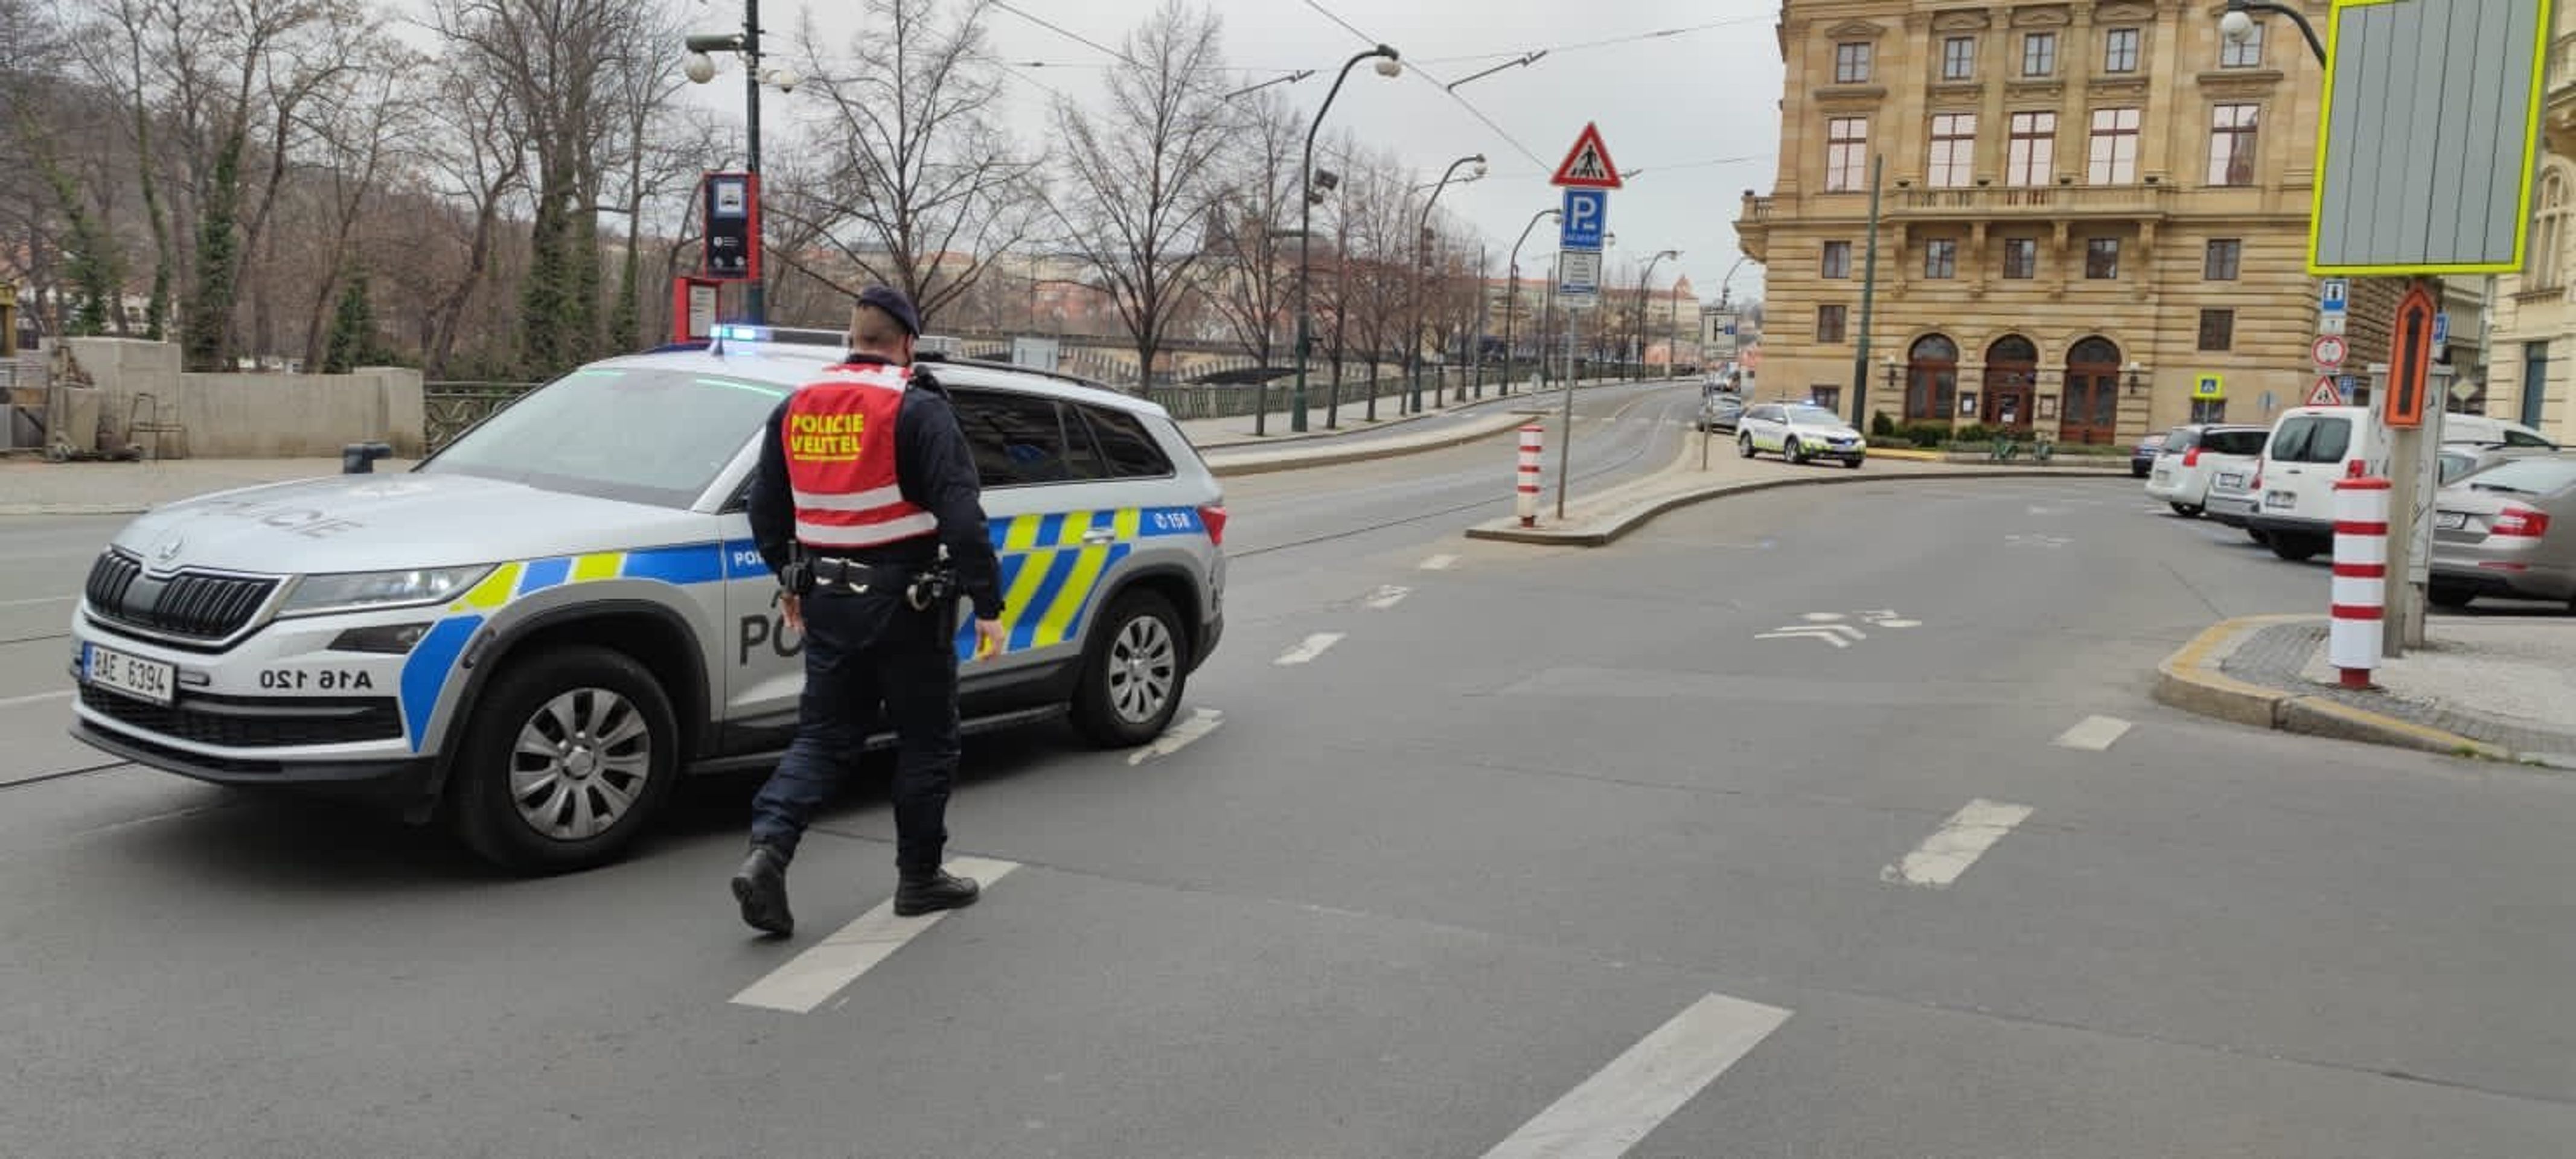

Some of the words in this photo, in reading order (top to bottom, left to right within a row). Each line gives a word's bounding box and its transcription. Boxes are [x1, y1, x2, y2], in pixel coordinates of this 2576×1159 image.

[1572, 196, 1597, 230] P
[791, 414, 864, 433] POLICIE
[129, 660, 165, 694] 6394
